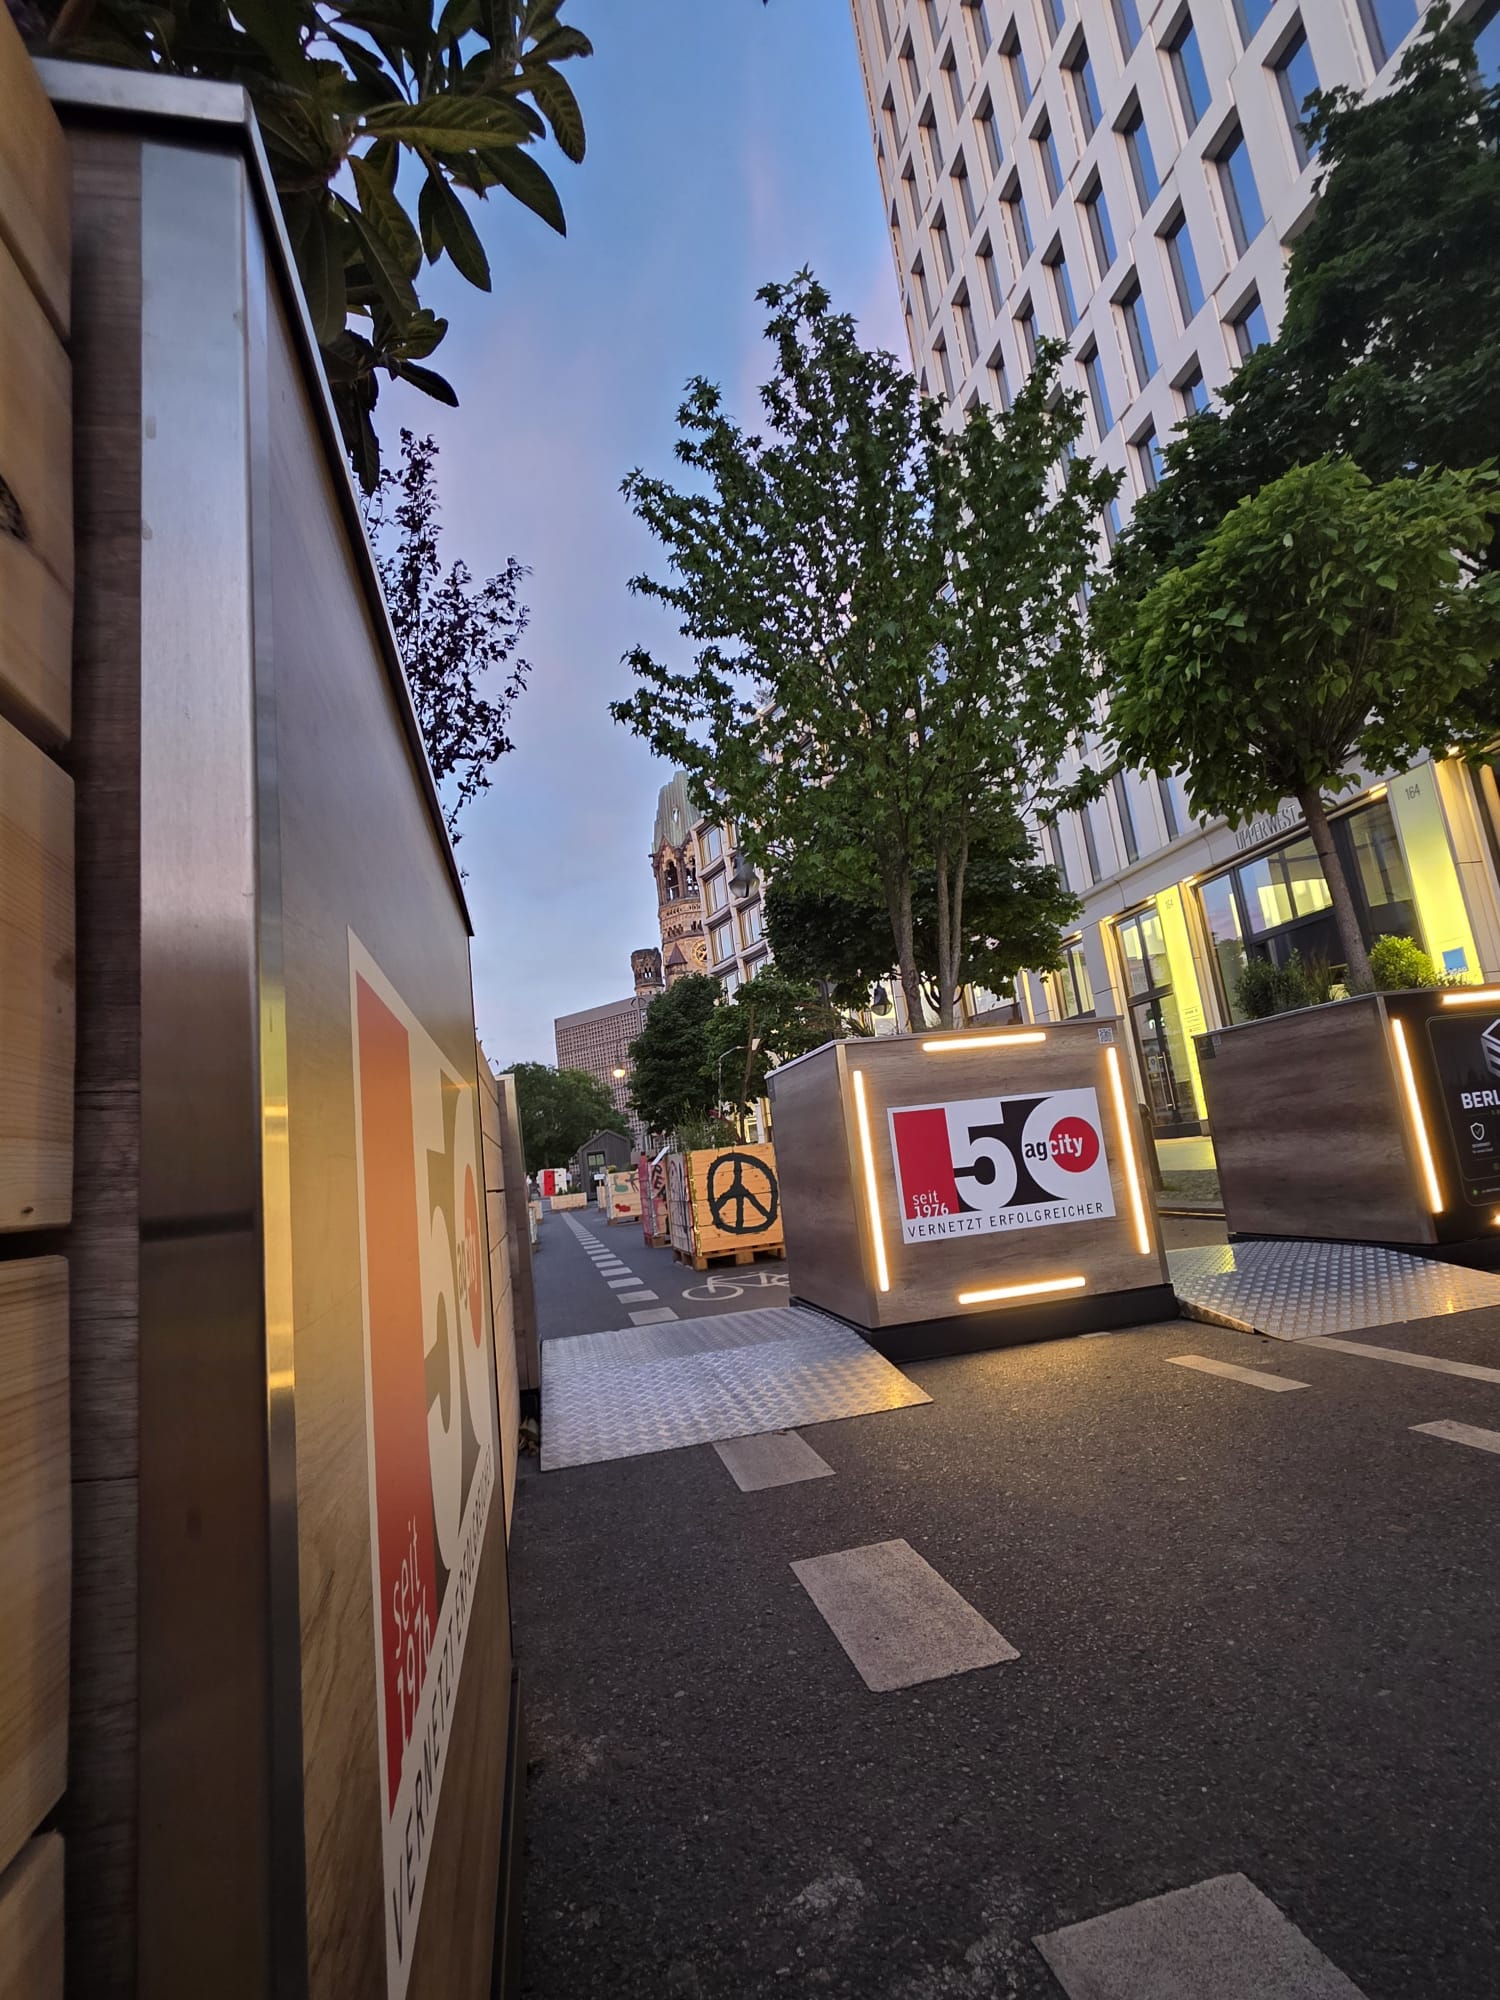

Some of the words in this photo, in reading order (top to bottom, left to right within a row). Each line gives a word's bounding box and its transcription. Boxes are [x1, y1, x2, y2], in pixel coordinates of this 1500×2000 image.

[1405, 783, 1420, 801] 164
[1235, 821, 1268, 850] UPPER
[1461, 1089, 1500, 1109] BERL
[1024, 1134, 1083, 1162] agcity
[912, 1190, 939, 1206] seit
[914, 1202, 949, 1219] 1976
[907, 1217, 983, 1238] VERNETZT
[989, 1202, 1104, 1227] ERFOLGREICHER
[393, 1514, 420, 1658] seit
[397, 1584, 432, 1770] 1976
[393, 1616, 455, 1968] VERNETZT
